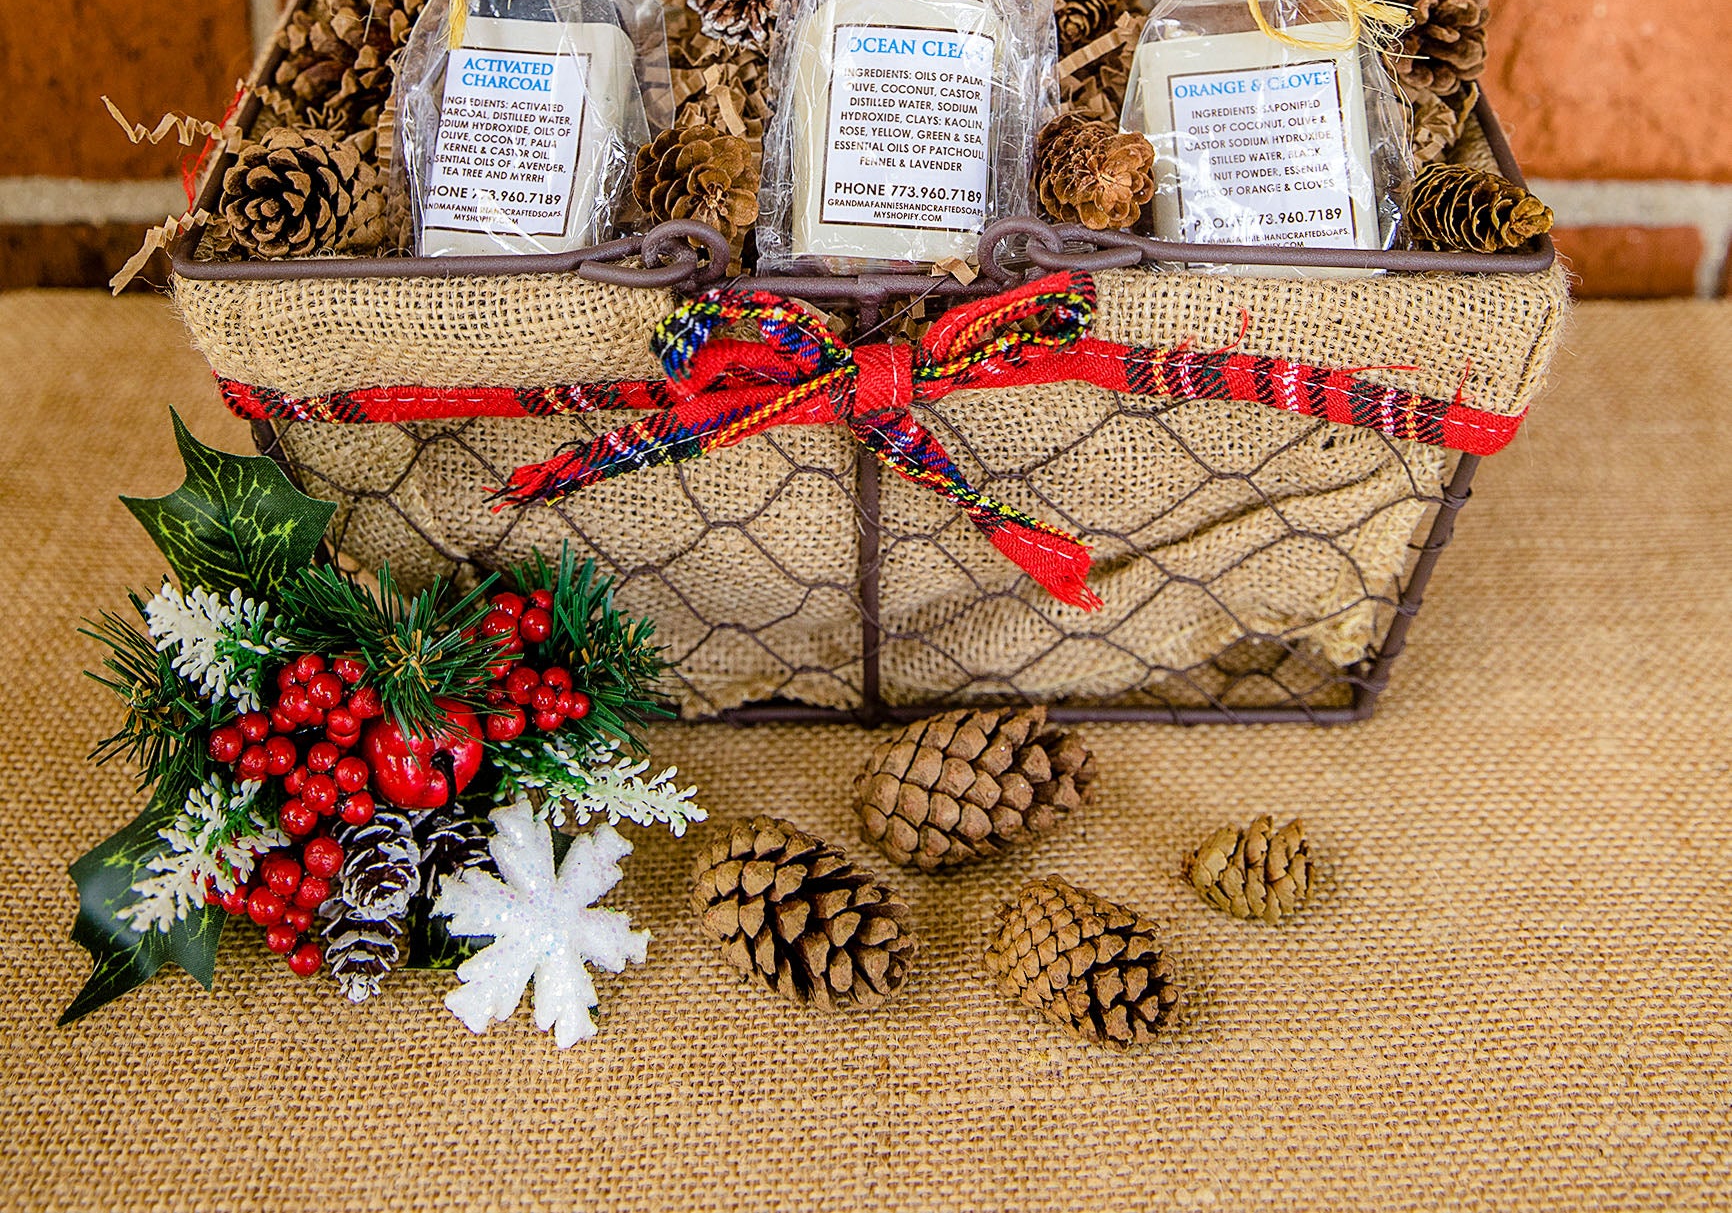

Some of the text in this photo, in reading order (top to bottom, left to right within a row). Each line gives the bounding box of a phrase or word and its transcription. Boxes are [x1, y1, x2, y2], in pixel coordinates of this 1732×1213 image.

[850, 37, 985, 62] OCEAN CLEA
[464, 58, 554, 76] ACTIVATED
[462, 74, 551, 92] CHARCOAL
[844, 68, 986, 87] INGREDIENTS: OILS OF PALM,
[1175, 71, 1331, 98] ORANGE & CLOVES
[847, 82, 983, 101] OLIVE, COCONUT, CASTOR,
[511, 102, 563, 113] ACTIVATED
[850, 97, 978, 114] DISTILLED WATER, SODIUM
[1192, 106, 1257, 120] INGREDIENTS:
[442, 108, 573, 126] HARCOAL, DISTILLED WATER,
[841, 112, 985, 131] HYDROXIDE, CLAYS: KAOLIN,
[1189, 115, 1327, 136] OILS OF COCONUT, OLIVE &
[440, 119, 571, 137] ODIUM HYDROXIDE, OILS OF
[441, 131, 471, 142] OLIVE,
[839, 126, 984, 146] ROSE, YELLOW, GREEN & SEA,
[444, 143, 478, 154] KERNEL
[480, 147, 487, 155] &
[835, 140, 986, 162] ESSENTIAL OILS OF PATCHOULI,
[1229, 137, 1269, 149] SODIUM
[434, 155, 566, 174] SENTIAL OILS OF AVENDER,
[860, 157, 962, 171] FENNEL & LAVENDER
[1209, 154, 1246, 166] ISTILLED
[1250, 152, 1285, 162] WATER,
[443, 167, 544, 183] TEA TREE AND MYRRH
[1236, 168, 1281, 180] POWDER,
[1285, 164, 1332, 176] ESSENTIA
[428, 186, 468, 198] HONE
[835, 182, 982, 204] PHONE 773.960.7189
[1220, 186, 1234, 196] OF
[1236, 184, 1281, 196] ORANGE
[1284, 183, 1290, 192] &
[1294, 179, 1335, 191] CLOVES
[874, 211, 942, 222] MYSHOPIFY.COM
